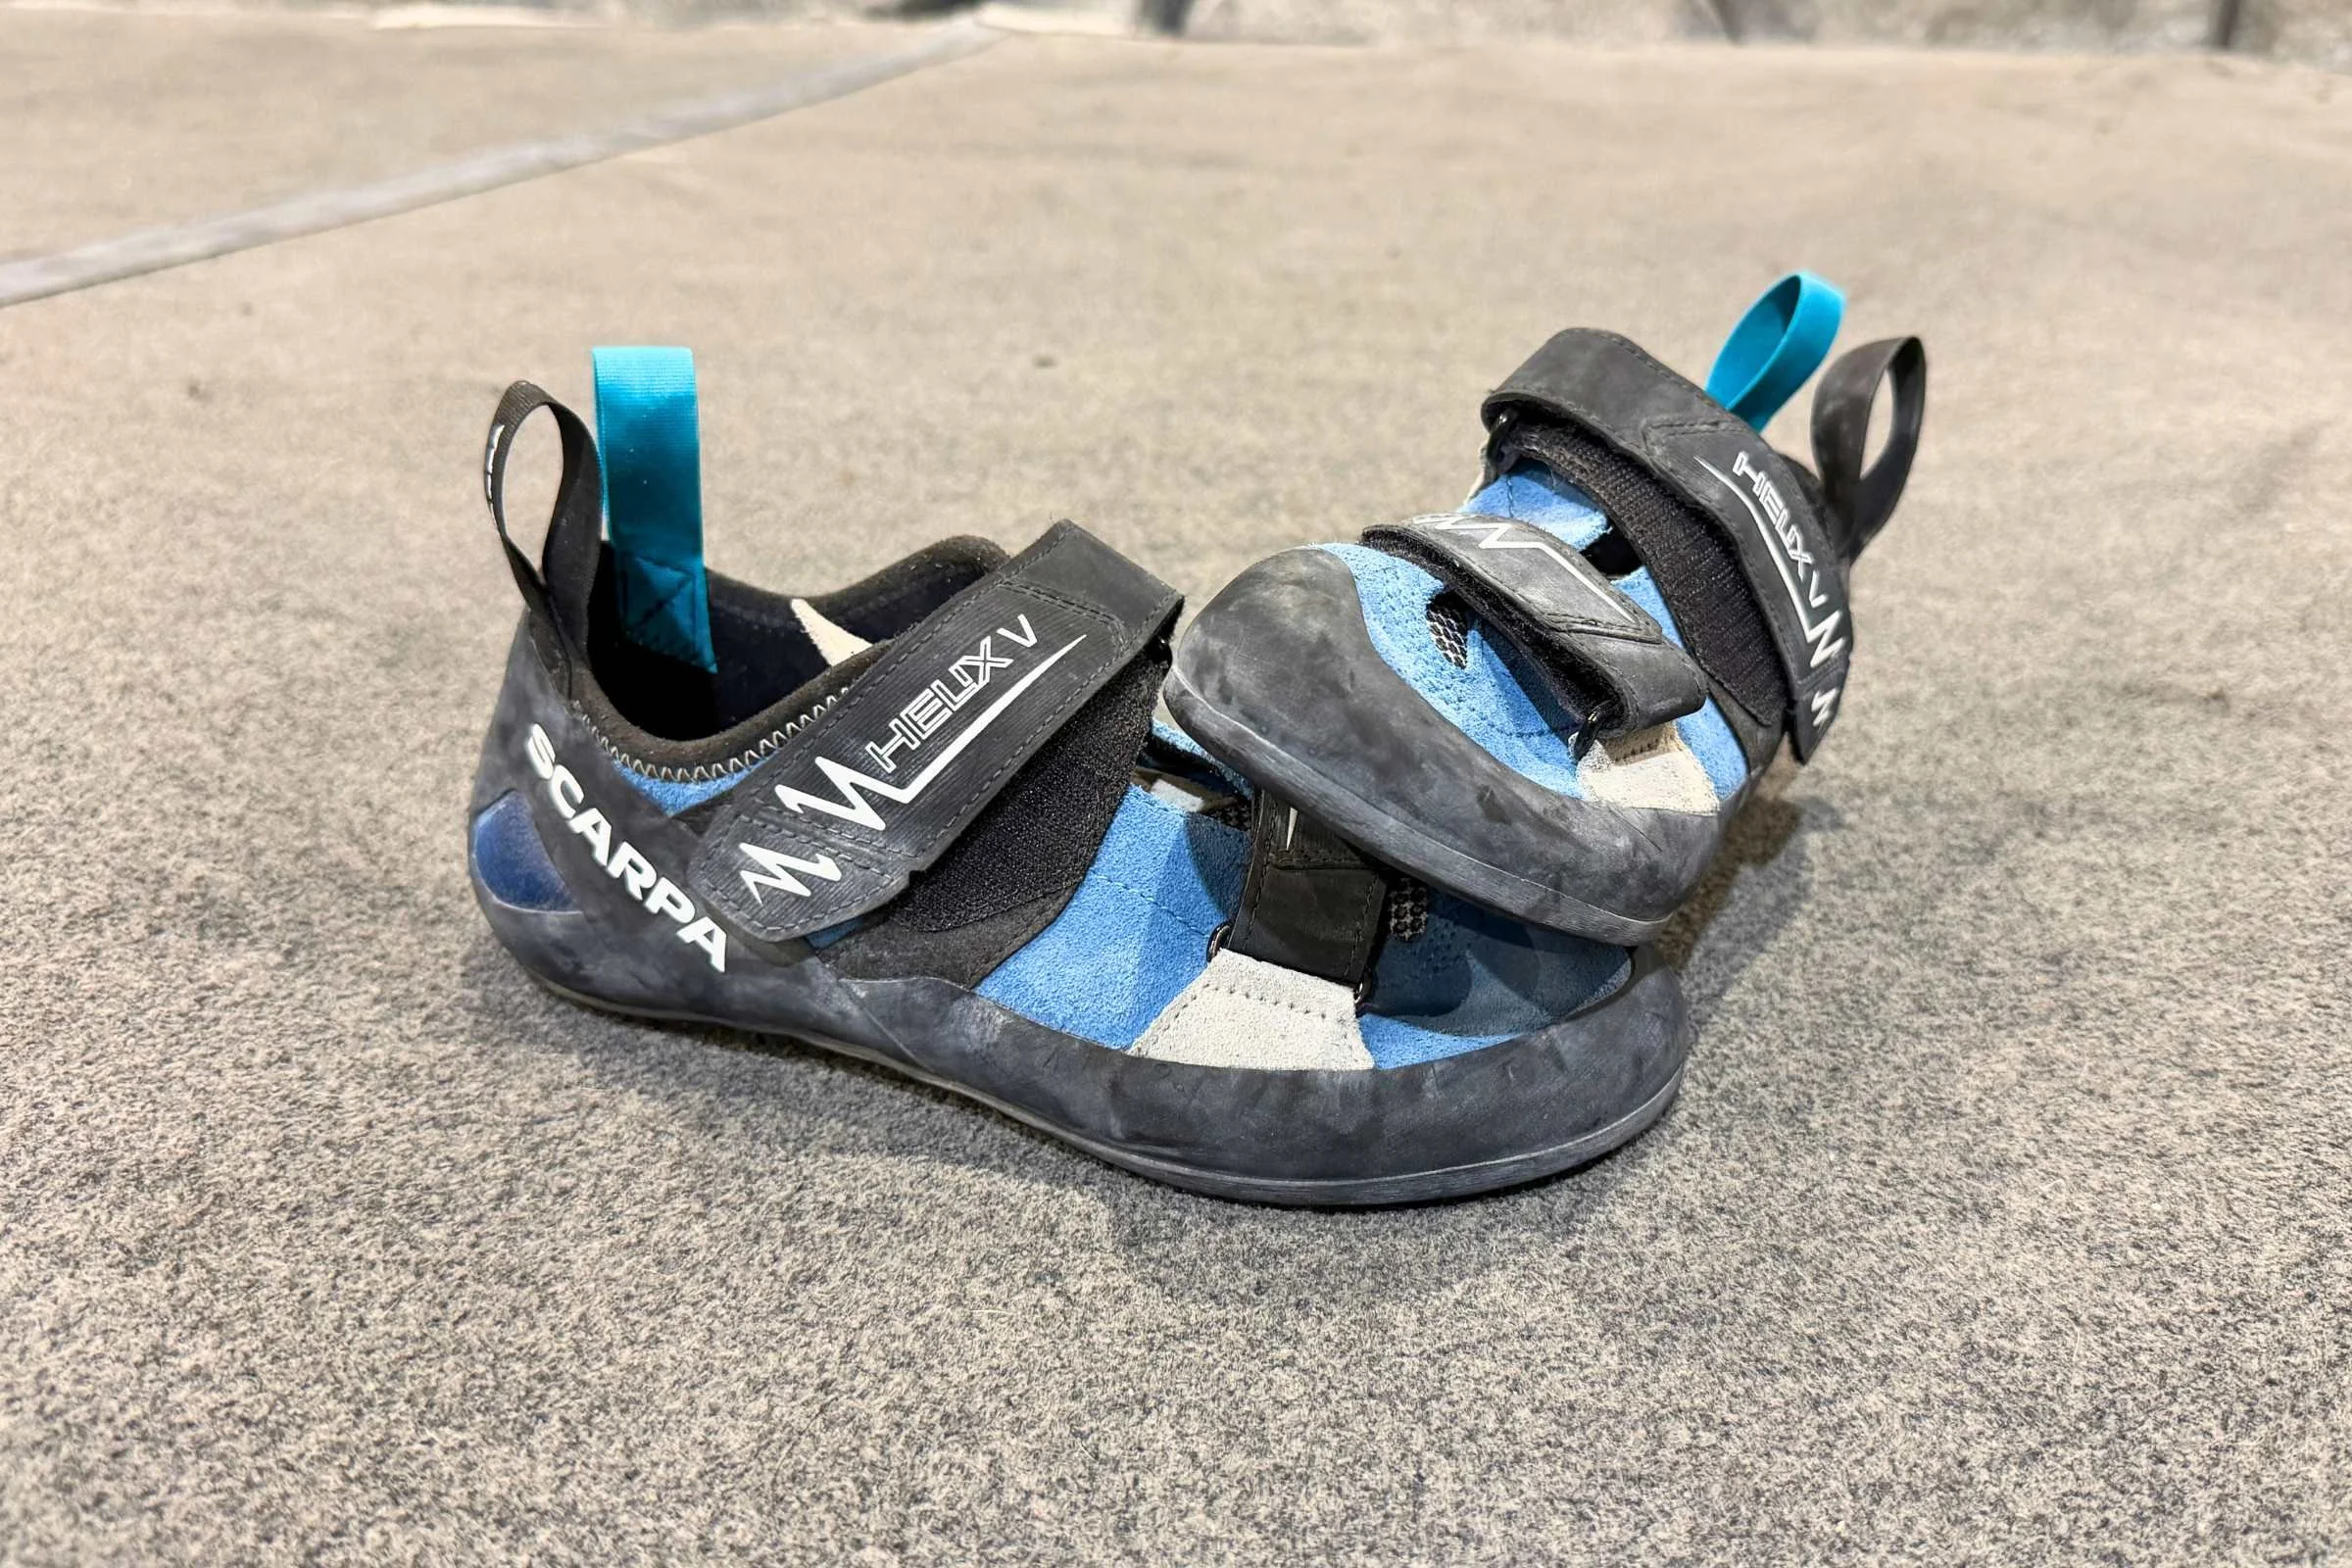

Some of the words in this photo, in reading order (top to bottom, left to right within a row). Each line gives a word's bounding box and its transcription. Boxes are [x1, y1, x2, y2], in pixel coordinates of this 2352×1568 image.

[1733, 451, 1813, 581] HELIX
[1808, 569, 1829, 609] V
[865, 636, 1014, 774] HELIX
[997, 612, 1040, 649] V
[524, 722, 728, 973] SCARPA
